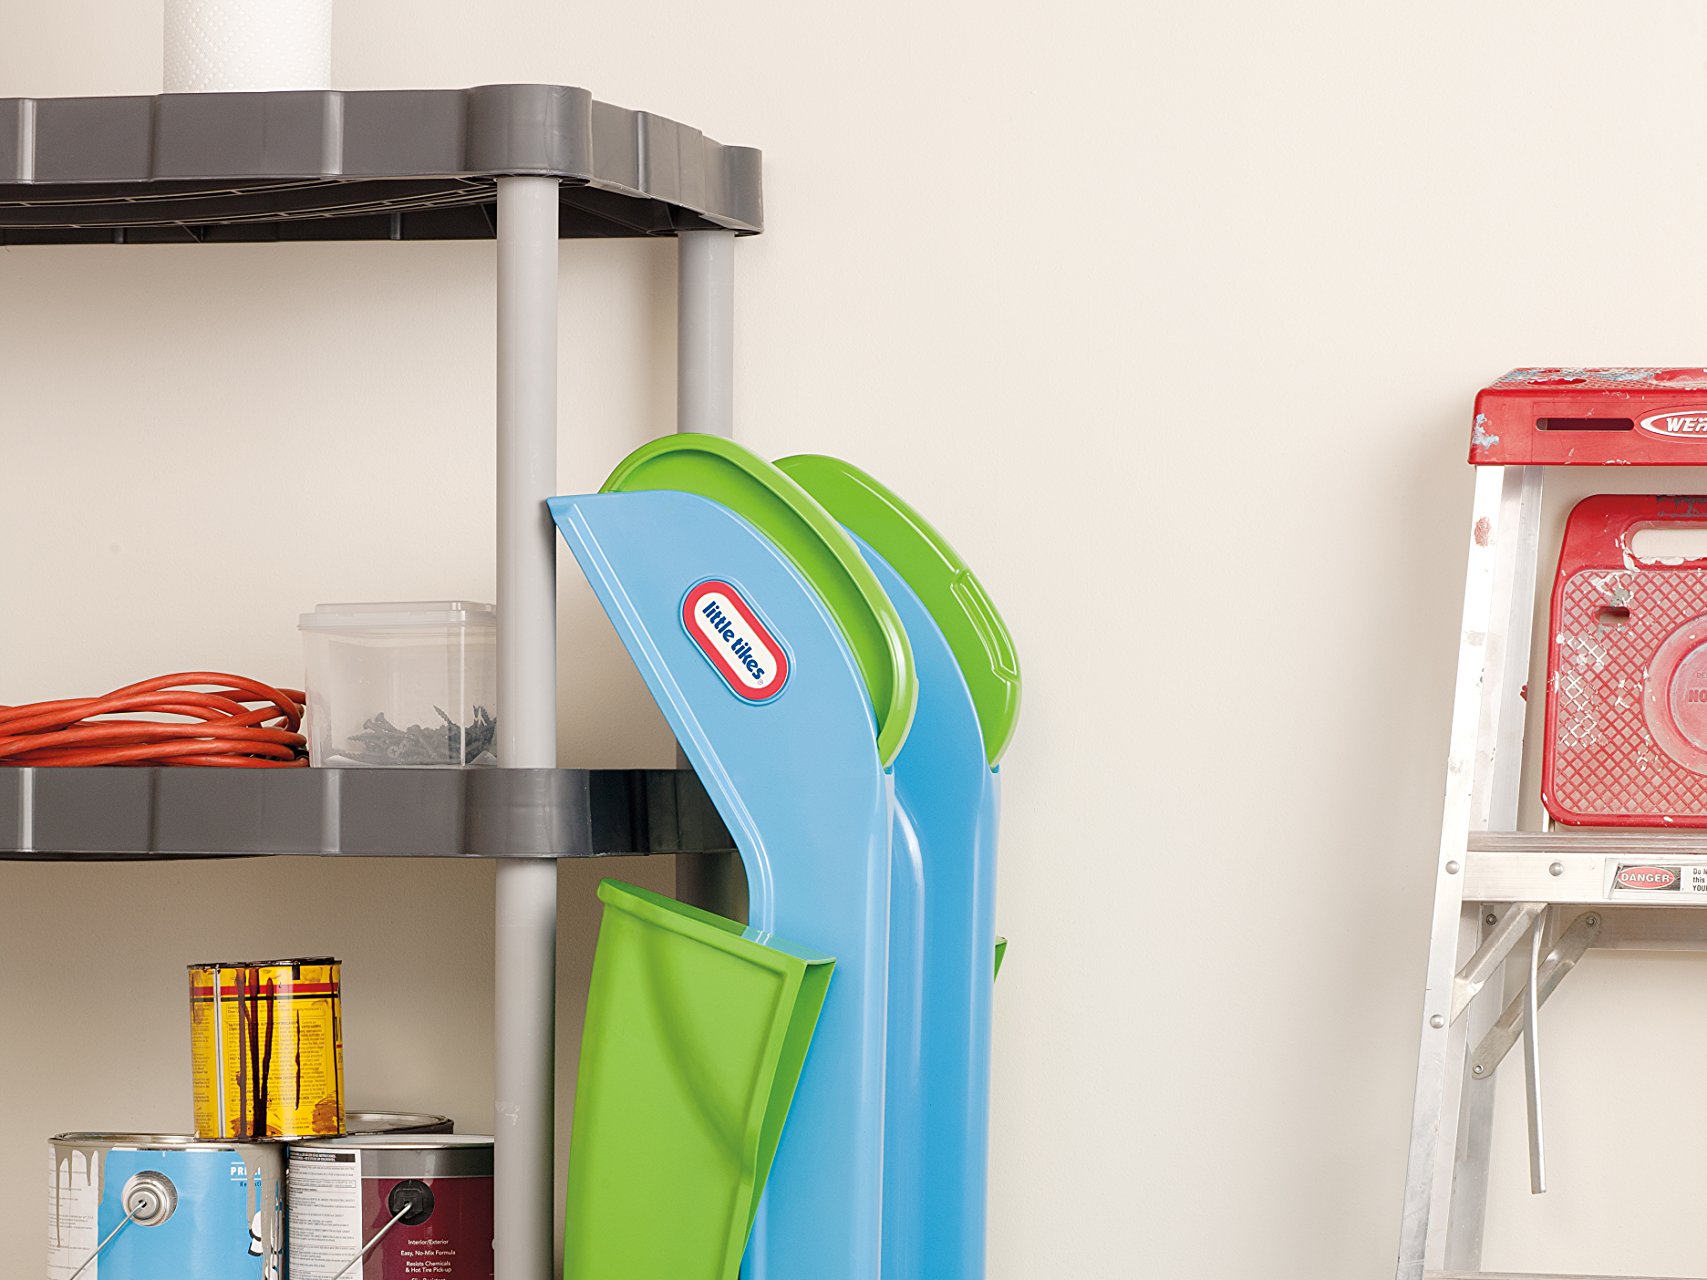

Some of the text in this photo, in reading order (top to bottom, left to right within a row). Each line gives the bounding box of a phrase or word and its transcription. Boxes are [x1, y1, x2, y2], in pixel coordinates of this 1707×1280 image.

[702, 600, 765, 680] little tikes
[1621, 873, 1670, 883] DANGER
